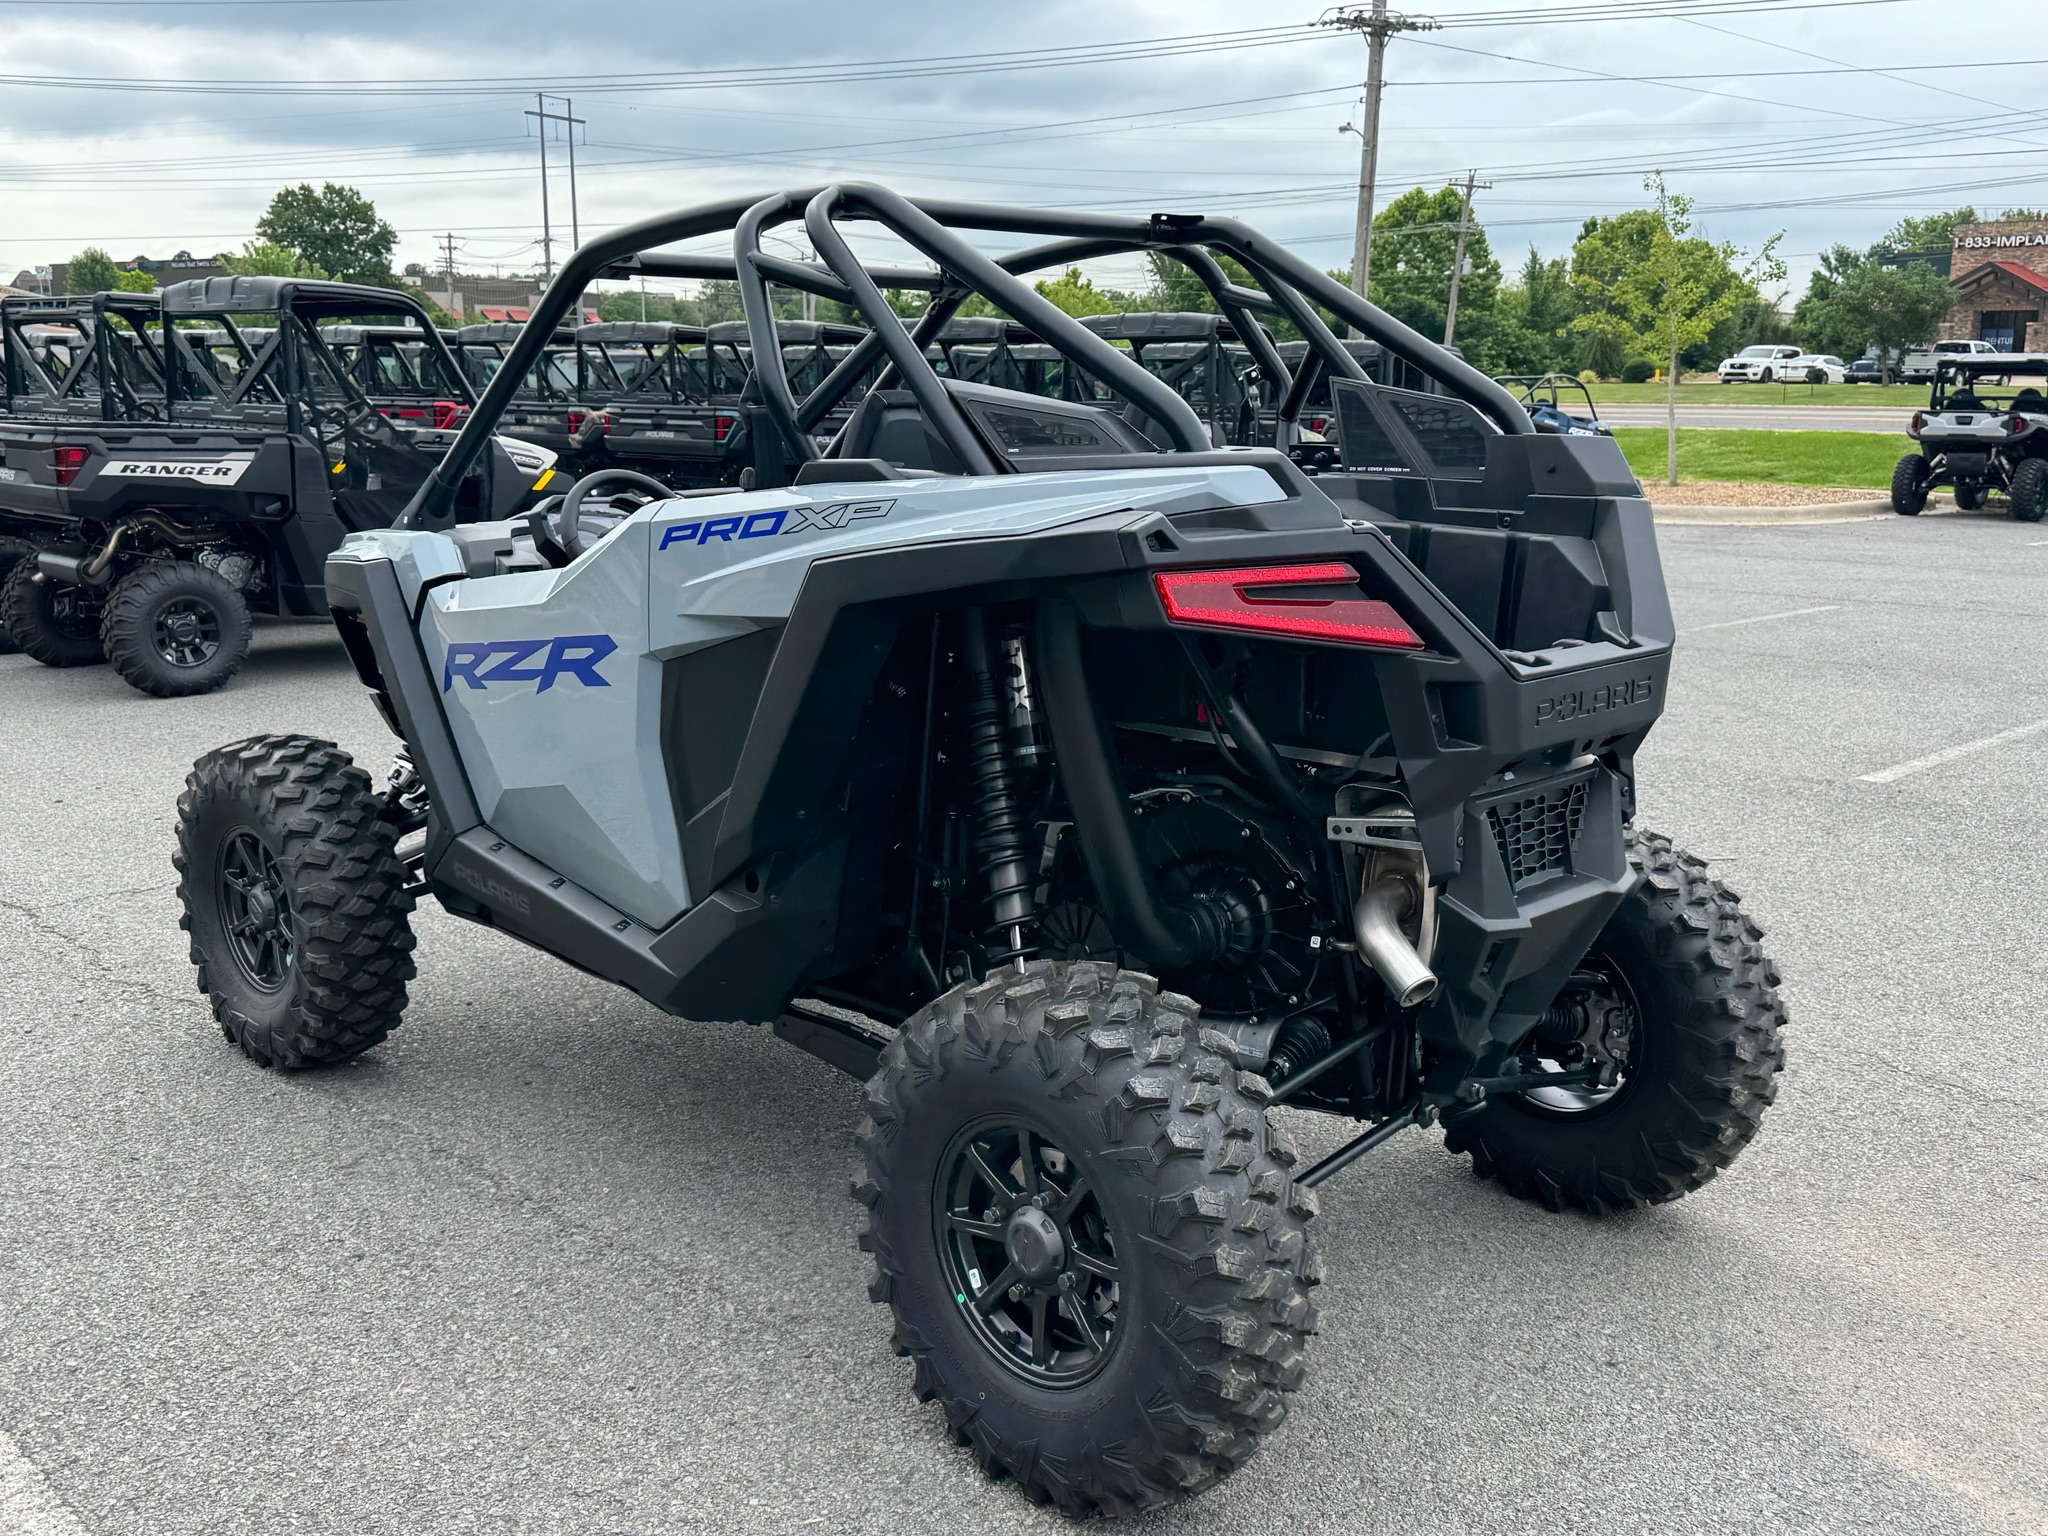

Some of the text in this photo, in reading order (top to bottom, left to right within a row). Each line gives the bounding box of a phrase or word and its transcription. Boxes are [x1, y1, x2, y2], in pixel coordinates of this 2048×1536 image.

[1953, 234, 2048, 249] 1-833-IMPLA
[645, 431, 675, 439] POLARIS
[119, 464, 233, 476] RANGER
[443, 634, 619, 695] RZR
[1534, 675, 1652, 728] POLARIS
[453, 862, 531, 915] POLARIS
